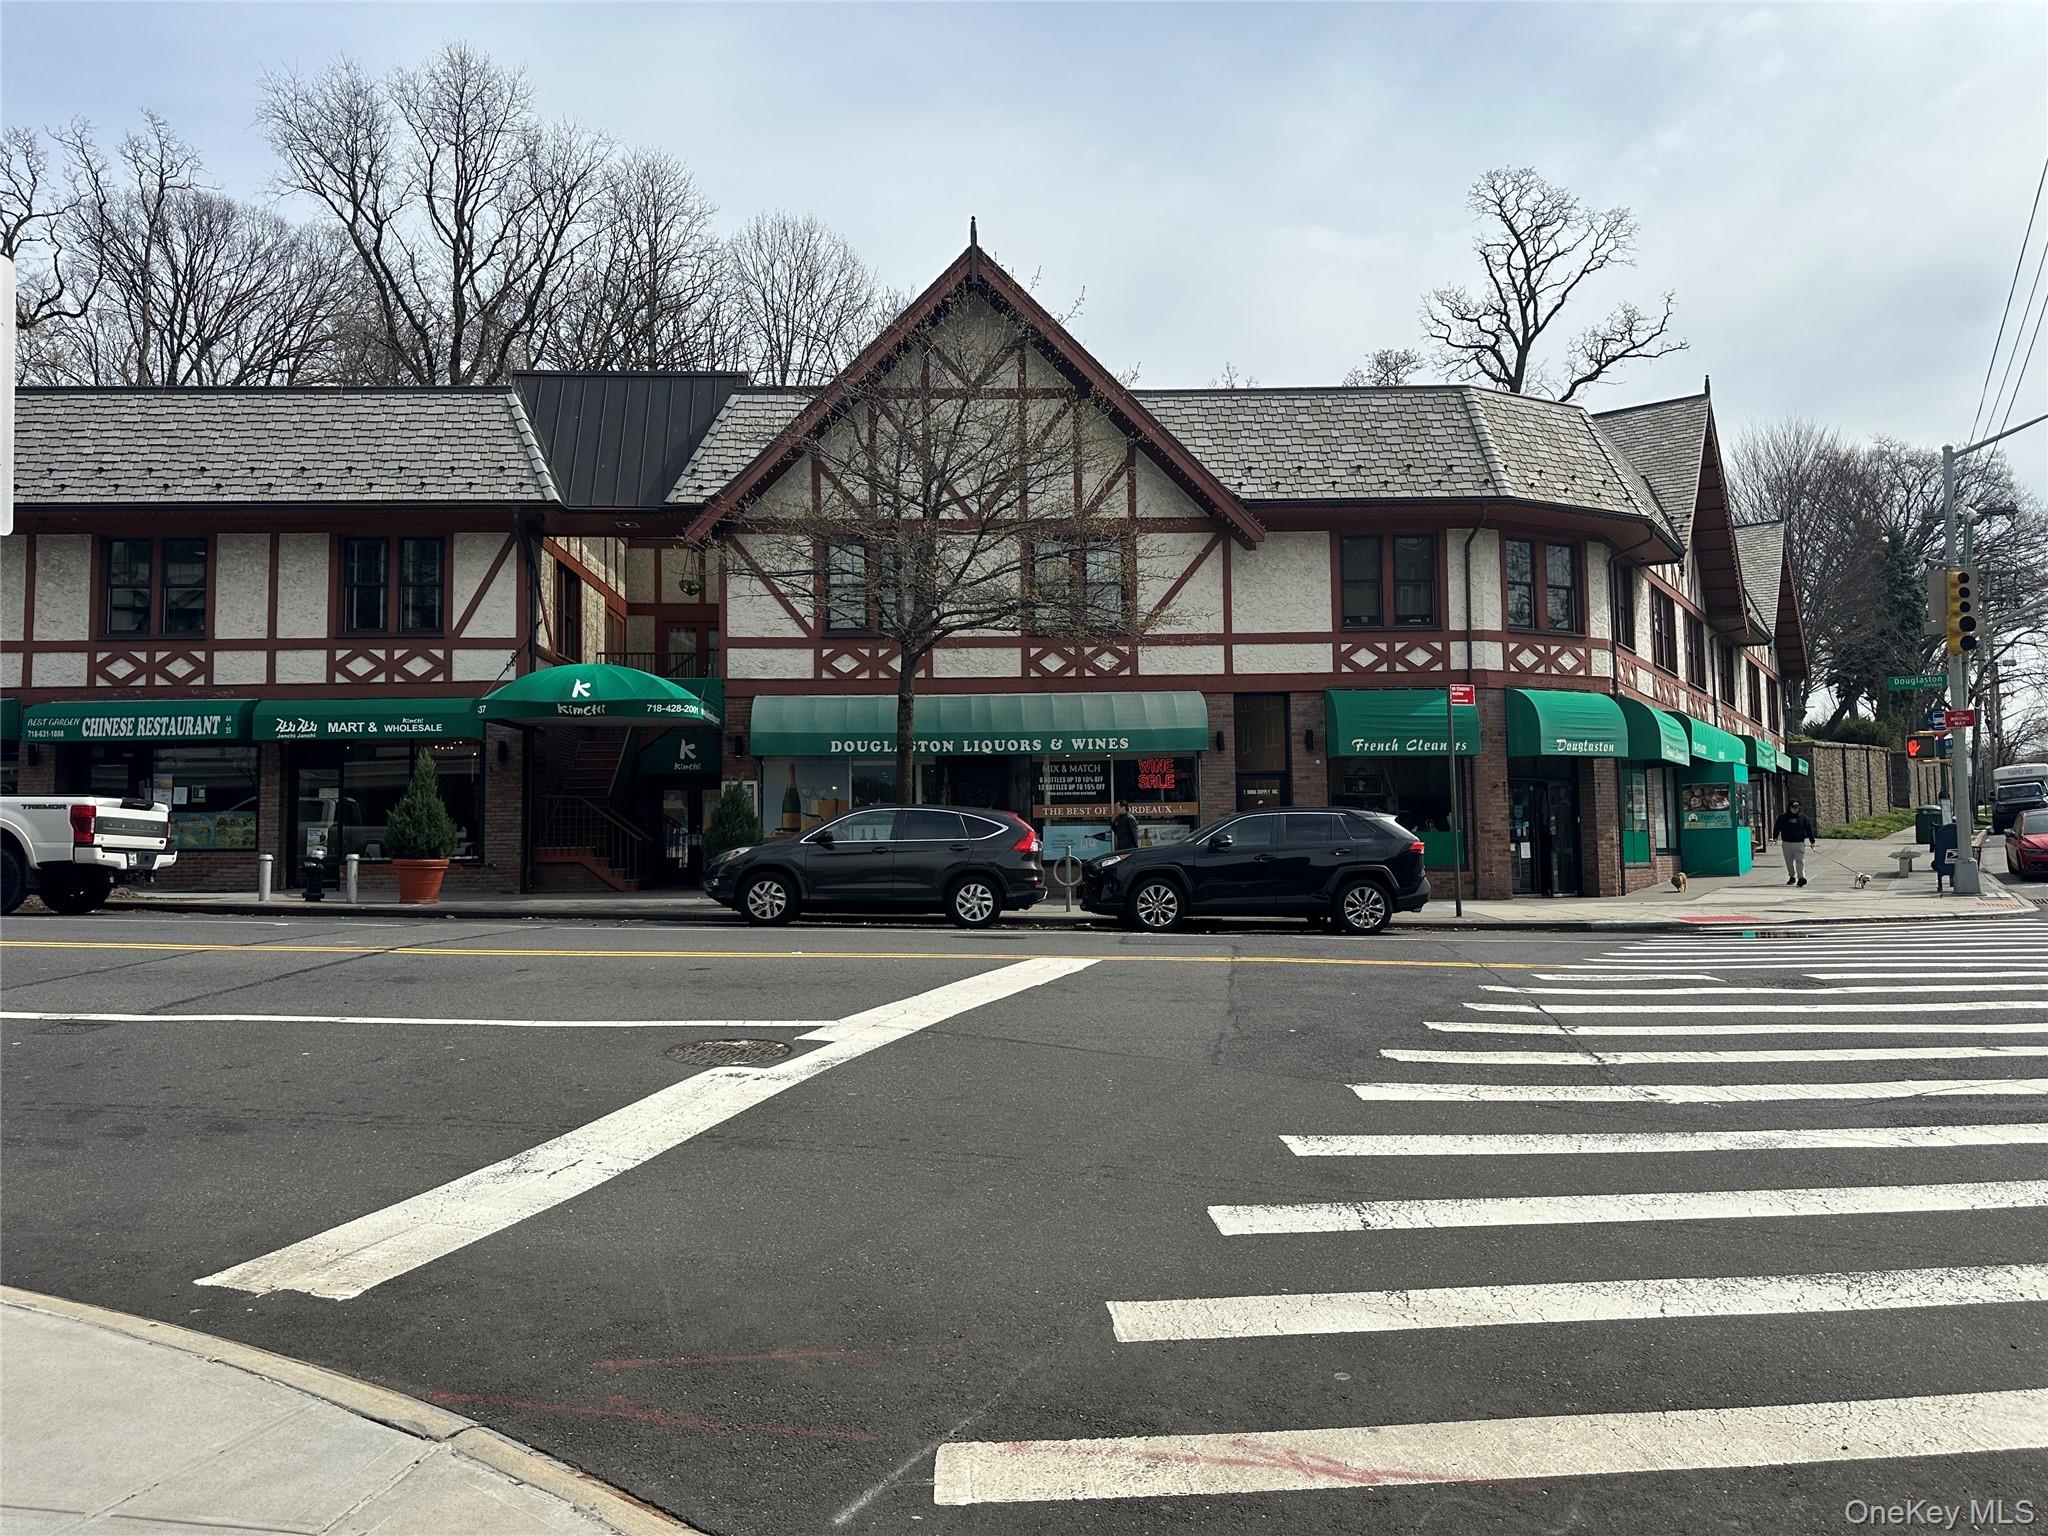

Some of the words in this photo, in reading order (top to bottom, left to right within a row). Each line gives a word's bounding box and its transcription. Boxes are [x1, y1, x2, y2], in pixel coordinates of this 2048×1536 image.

[1894, 675, 1943, 686] Douglaston
[571, 679, 591, 698] K
[477, 705, 487, 714] 37
[27, 718, 48, 726] BEST
[48, 717, 81, 726] GARDEN
[81, 717, 135, 738] CHINESE
[136, 715, 221, 737] RESTAURANT
[327, 721, 365, 733] MART
[367, 721, 378, 733] &
[384, 723, 443, 733] WHOLESALE
[679, 738, 697, 760] K
[830, 740, 953, 752] DOUGLSTON
[963, 739, 1042, 753] LIQUORS
[1050, 738, 1063, 750] &
[1071, 737, 1130, 750] WINES
[1351, 738, 1399, 751] French
[1406, 739, 1468, 751] Cleanrs
[1556, 739, 1615, 753] Douglaston
[1042, 764, 1059, 773] MIX
[1061, 764, 1068, 773] &
[1069, 764, 1101, 773] MATCH
[1138, 758, 1174, 774] WINE
[1138, 774, 1175, 789] SALE
[21, 803, 67, 811] TREMOR
[1043, 806, 1062, 816] THE
[1065, 806, 1092, 816] BEST
[1094, 806, 1109, 816] OF
